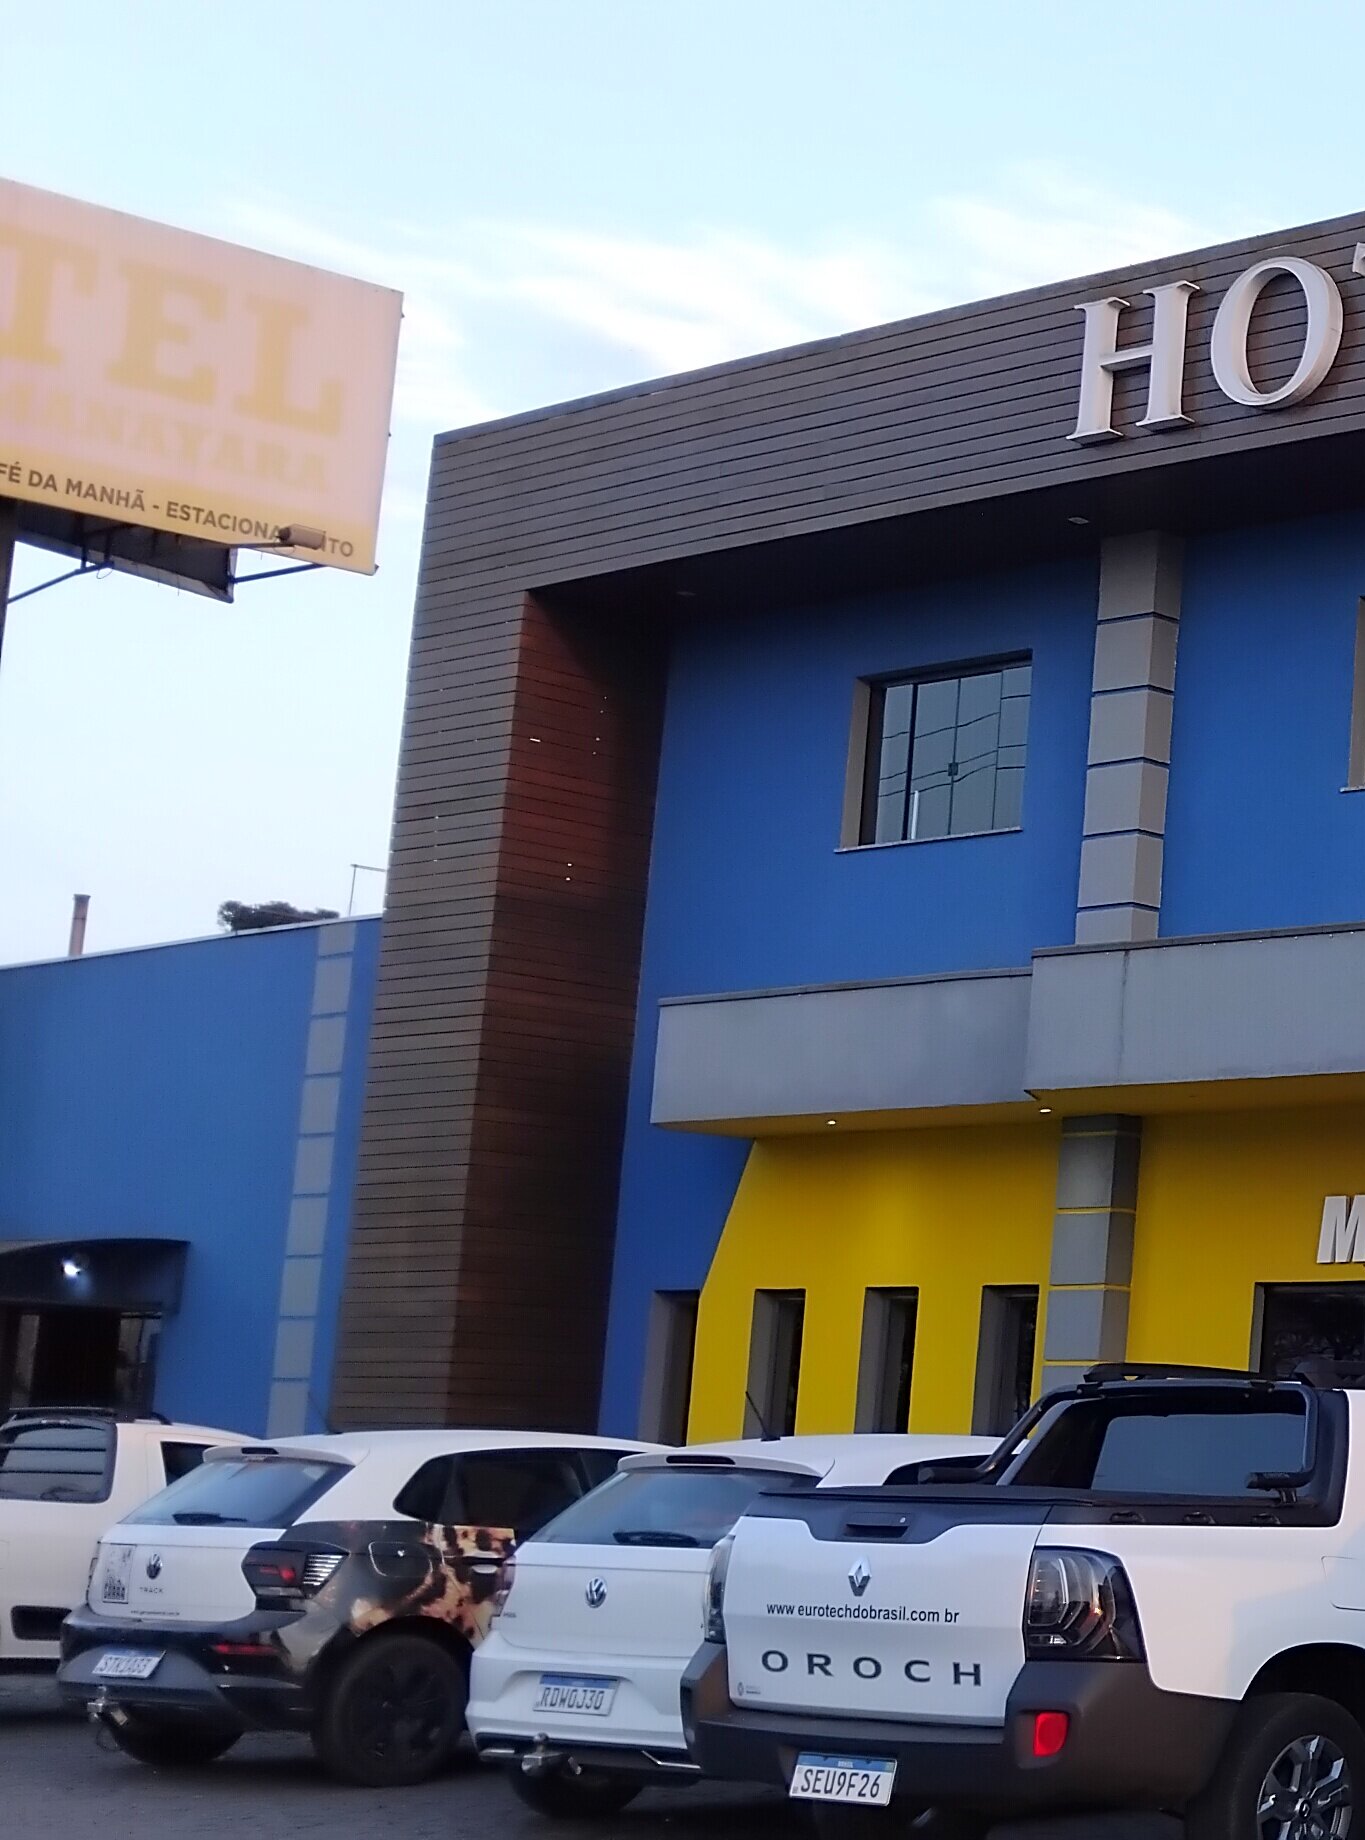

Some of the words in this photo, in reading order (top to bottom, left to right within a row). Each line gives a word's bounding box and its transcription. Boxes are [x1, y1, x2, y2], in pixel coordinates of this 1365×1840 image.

[28, 469, 58, 492] DA
[65, 478, 145, 511] MANHÃ
[166, 500, 354, 557] ESTACIONATO
[761, 1650, 981, 1686] OROCH
[801, 1769, 881, 1798] SEU9F26
